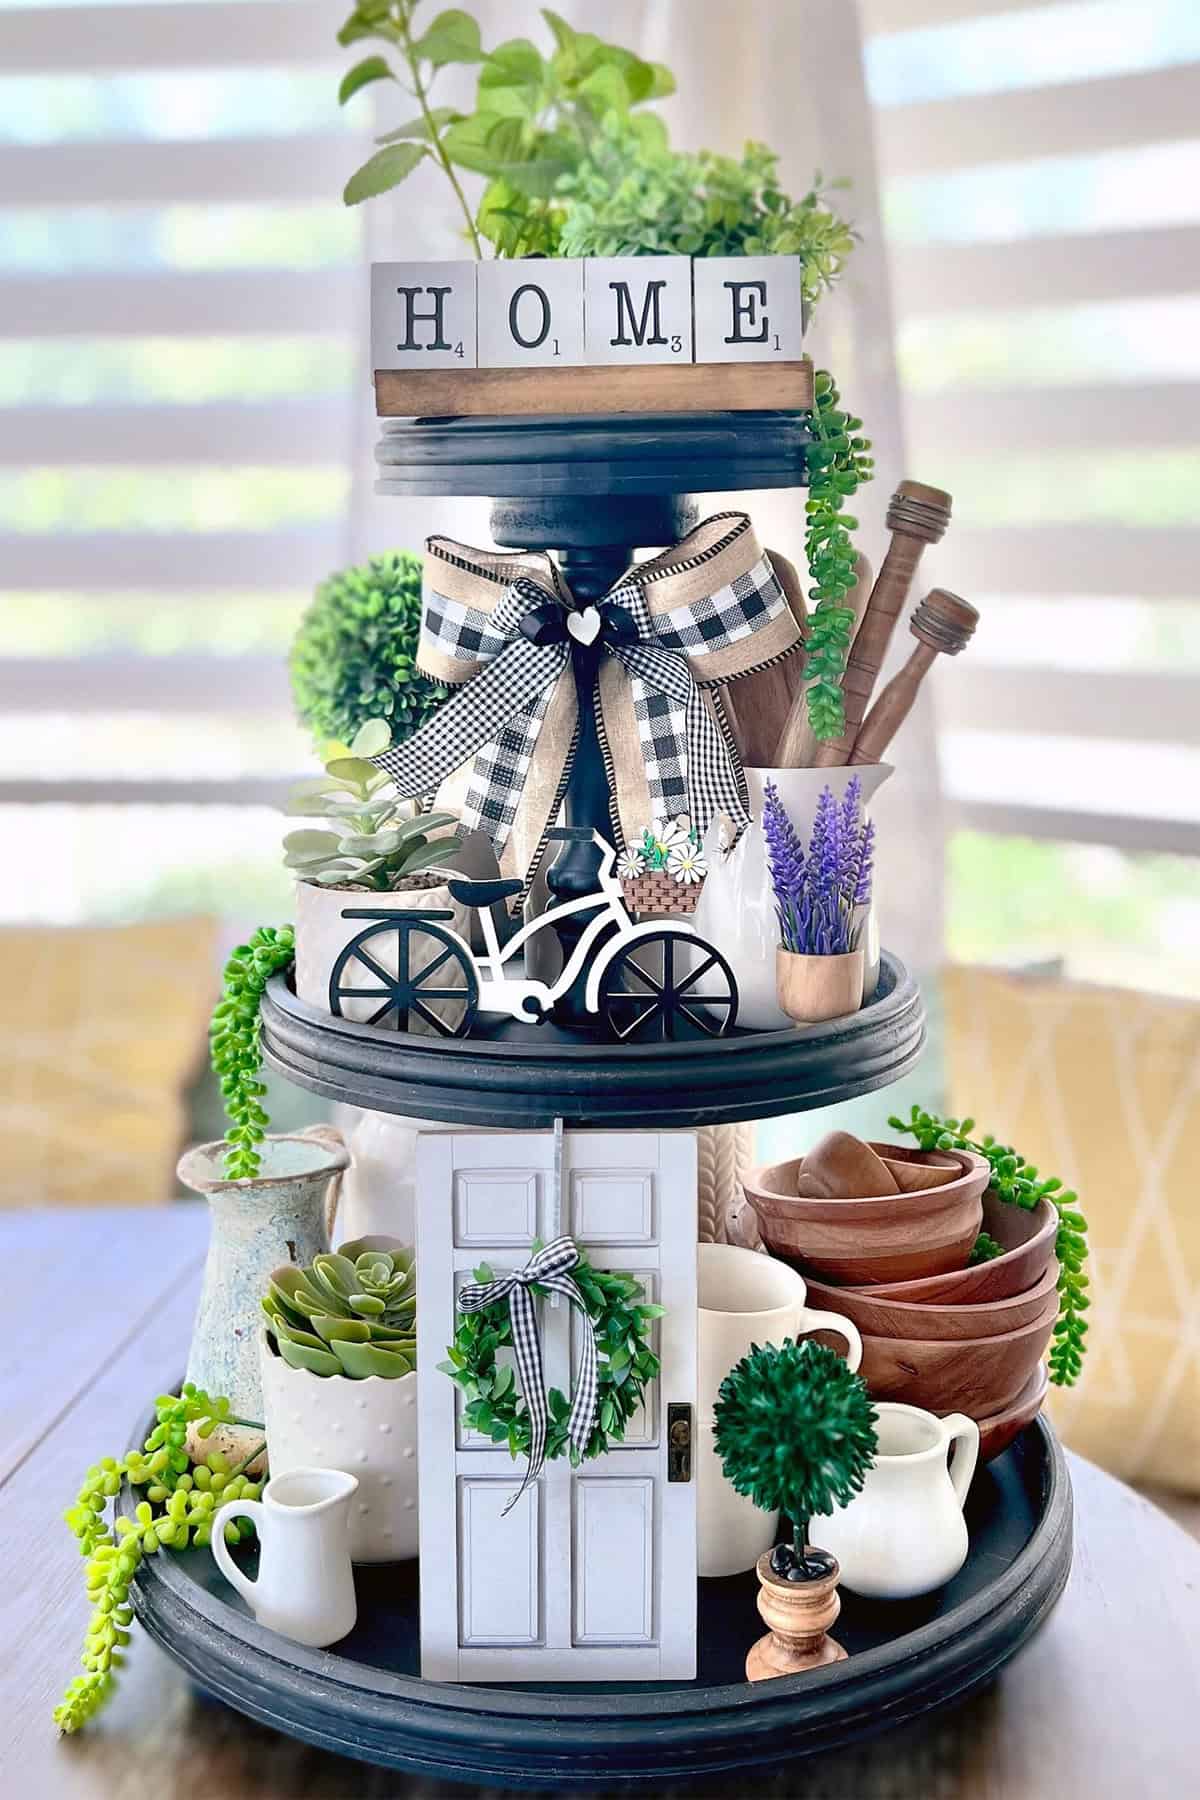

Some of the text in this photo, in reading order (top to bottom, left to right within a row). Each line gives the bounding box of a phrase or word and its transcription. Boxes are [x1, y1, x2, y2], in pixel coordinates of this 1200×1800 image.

[396, 280, 769, 352] HOME
[454, 341, 465, 358] 4
[552, 340, 561, 356] 1
[671, 335, 683, 353] 3
[773, 334, 782, 351] 1
